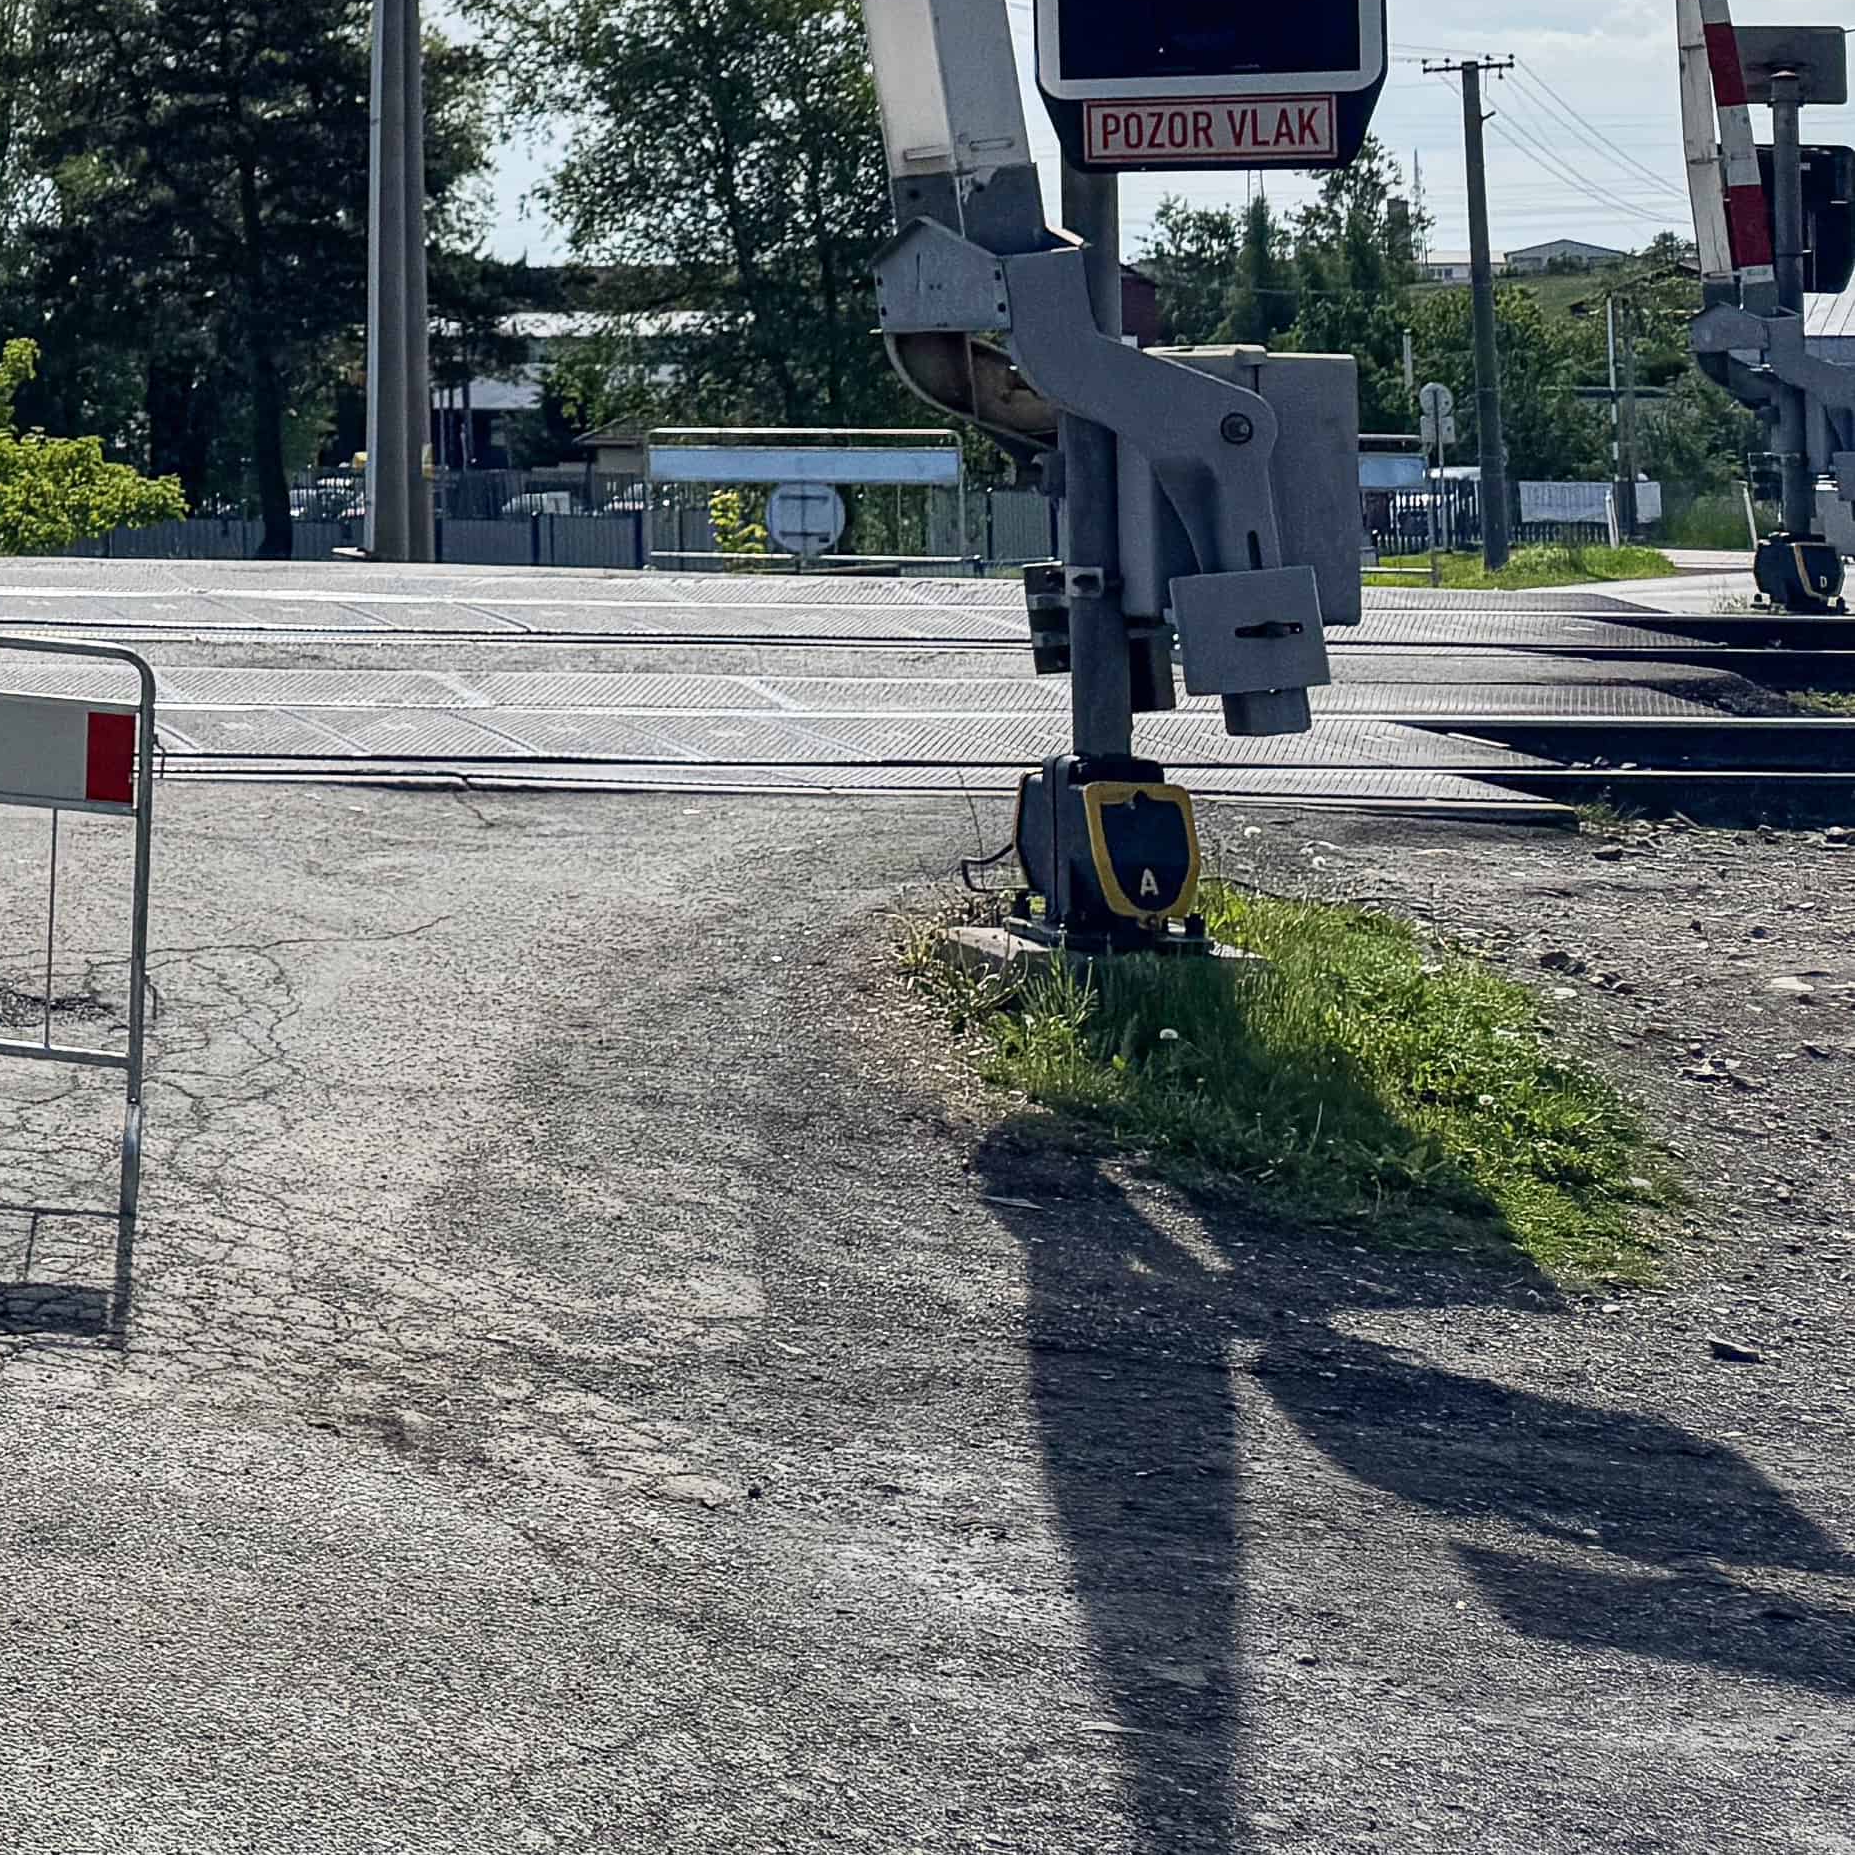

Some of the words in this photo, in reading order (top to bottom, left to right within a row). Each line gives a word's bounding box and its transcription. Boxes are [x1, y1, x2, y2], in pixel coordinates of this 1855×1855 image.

[1102, 110, 1214, 150] POZOR
[1226, 105, 1320, 147] VLAK
[1139, 867, 1159, 896] A
